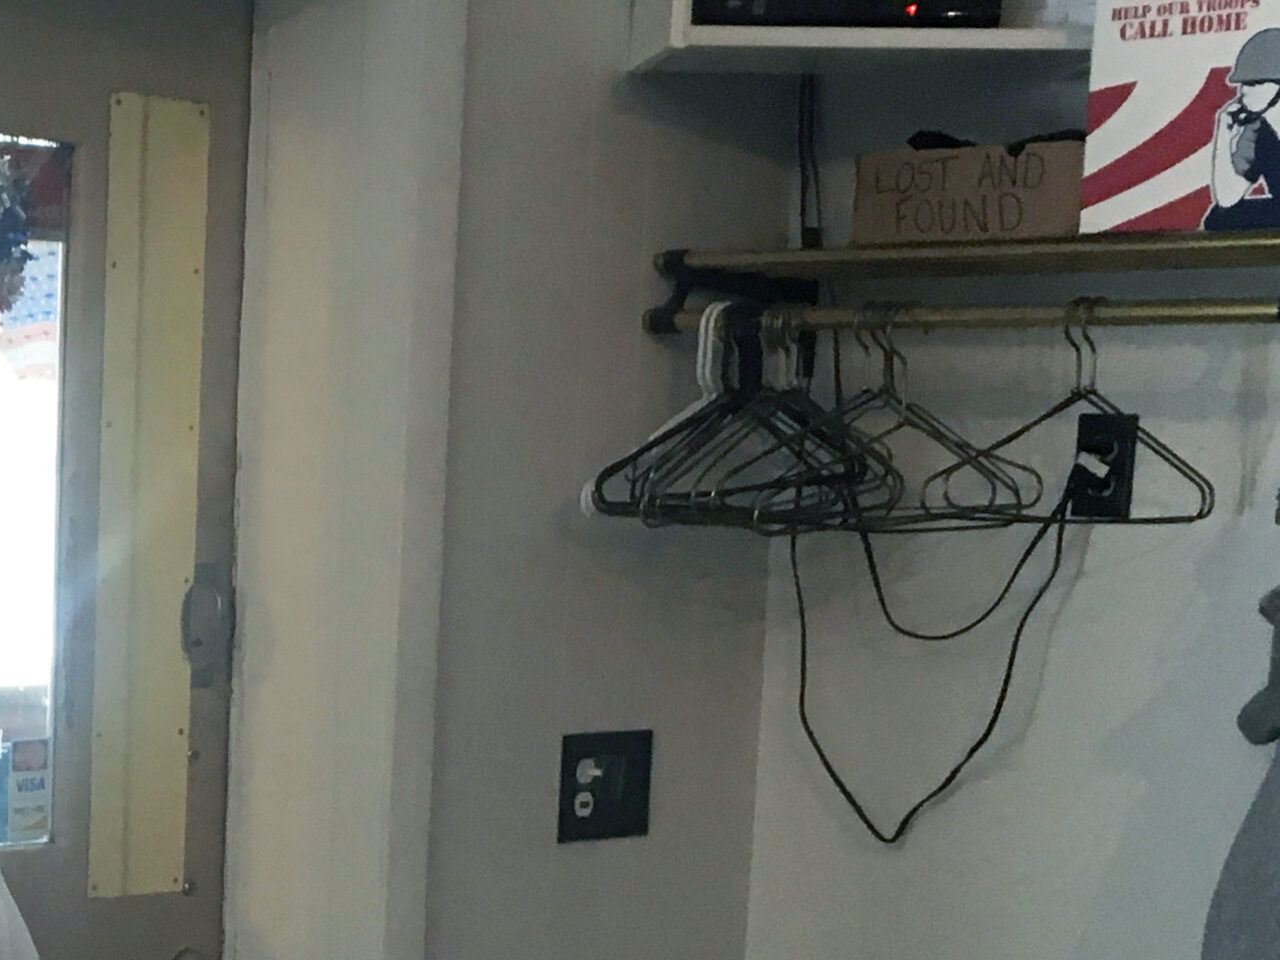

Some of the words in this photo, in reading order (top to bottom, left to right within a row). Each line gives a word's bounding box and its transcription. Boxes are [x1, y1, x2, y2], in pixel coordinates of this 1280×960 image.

[1111, 4, 1151, 21] HELP
[1156, 1, 1190, 16] OUR
[1120, 18, 1173, 41] CALL
[1181, 12, 1248, 36] HOME
[875, 155, 959, 194] LOST
[978, 152, 1045, 191] AND
[895, 192, 1022, 235] FOUND
